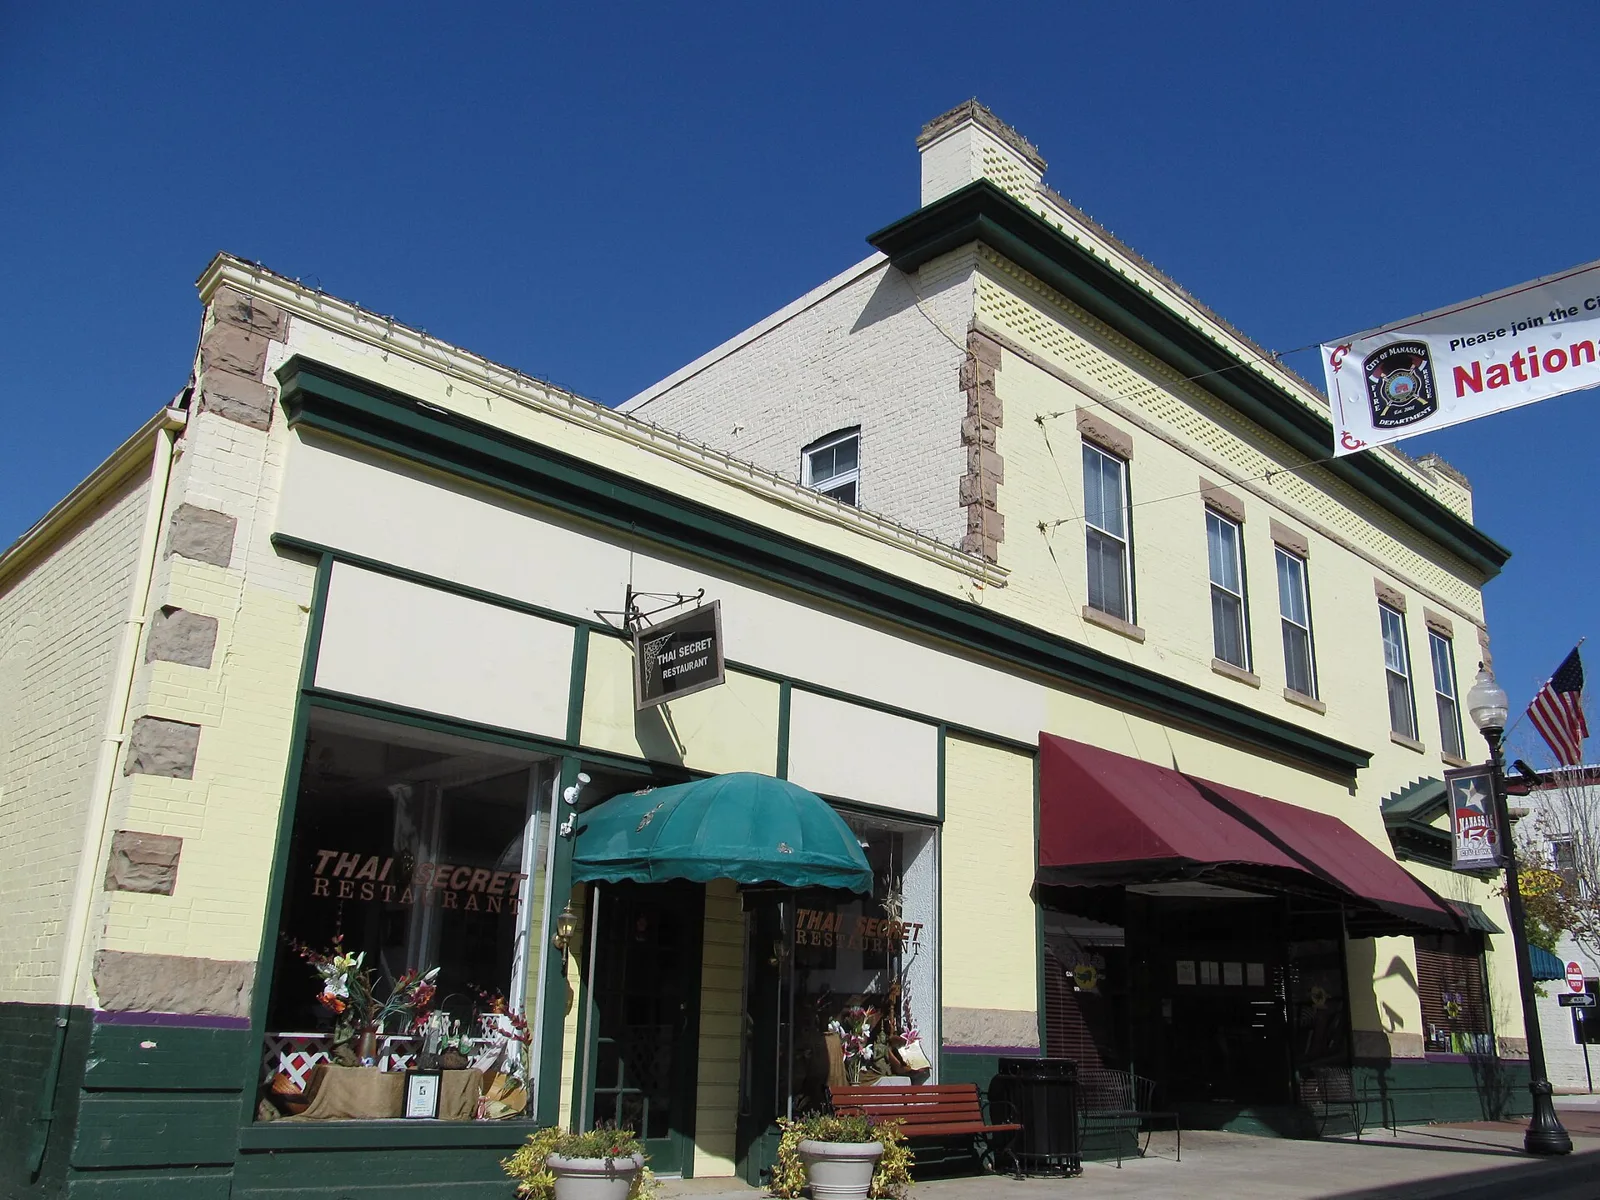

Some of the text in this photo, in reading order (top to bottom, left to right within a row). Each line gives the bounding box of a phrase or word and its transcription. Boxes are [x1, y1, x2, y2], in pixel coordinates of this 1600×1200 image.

[1450, 328, 1506, 351] Please
[1511, 316, 1543, 337] join
[1549, 306, 1578, 322] the
[1453, 339, 1600, 398] Nation
[1423, 369, 1433, 399] RESCUE
[1371, 385, 1380, 412] FIRE
[1379, 406, 1432, 426] DEPARTMENT
[657, 637, 712, 665] THAI SECRET
[662, 656, 708, 679] RESTAURANT
[1459, 814, 1494, 831] MANASSAS
[1455, 829, 1499, 850] 150
[314, 849, 529, 896] THAI SECRET
[312, 877, 522, 916] RESTAURANT
[796, 908, 924, 942] THAI SECRET
[796, 929, 921, 956] RESTAURANT
